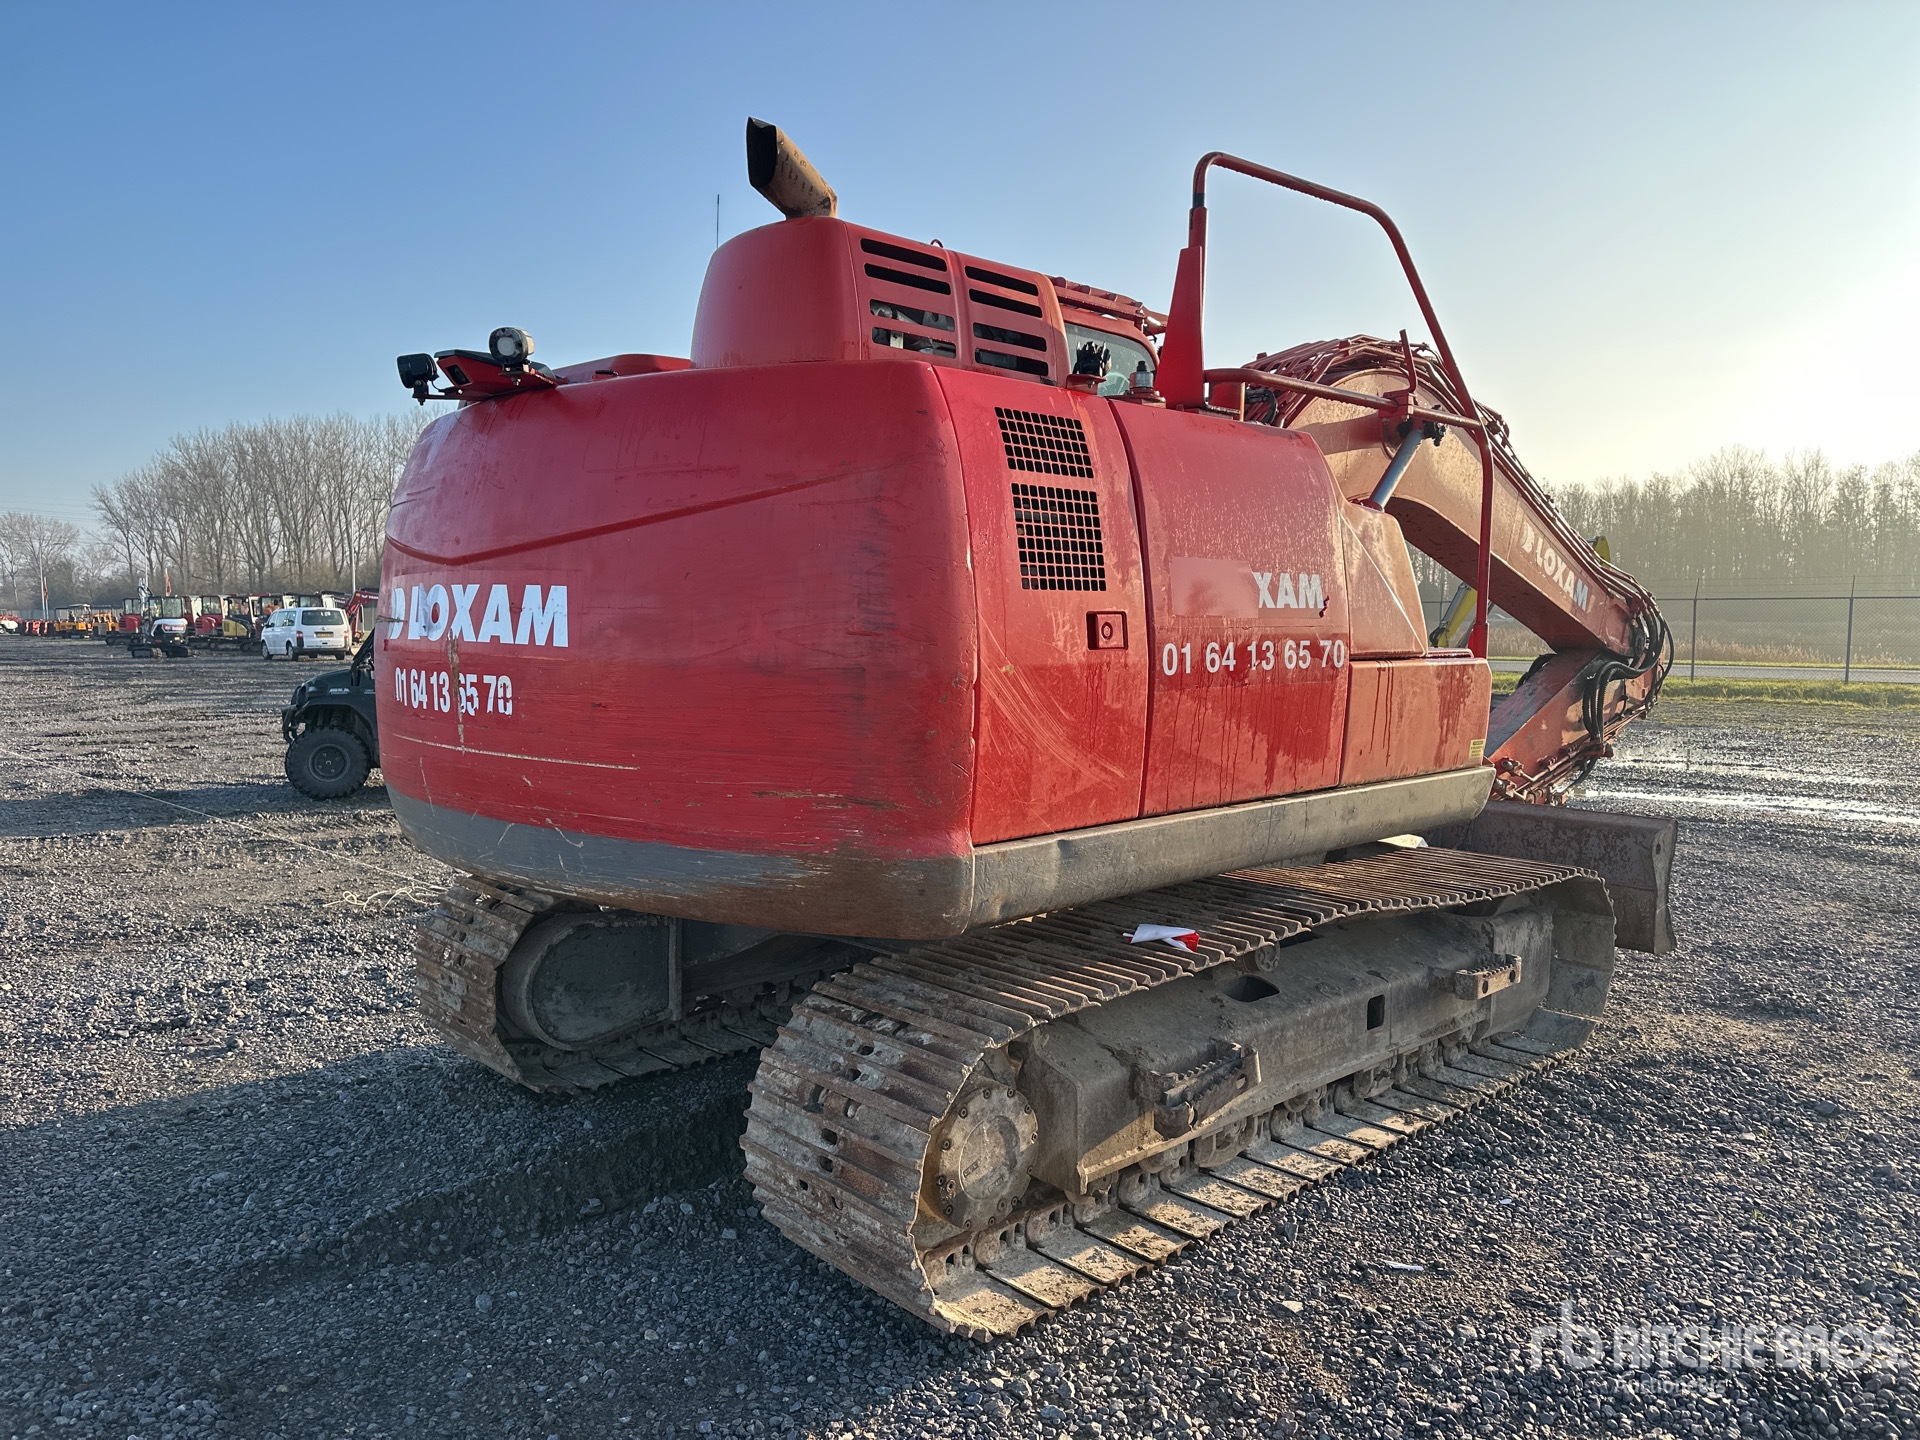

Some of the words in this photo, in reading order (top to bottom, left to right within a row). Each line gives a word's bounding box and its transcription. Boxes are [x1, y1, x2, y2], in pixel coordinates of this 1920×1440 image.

[1162, 642, 1192, 676] 01
[1205, 641, 1237, 673] 64
[1247, 640, 1275, 671] 13
[1284, 639, 1311, 670] 65
[1319, 639, 1345, 669] 70
[395, 666, 407, 707] 01
[410, 668, 428, 710] 64
[430, 671, 450, 713] 13
[459, 672, 479, 716] 65
[483, 675, 513, 716] 70
